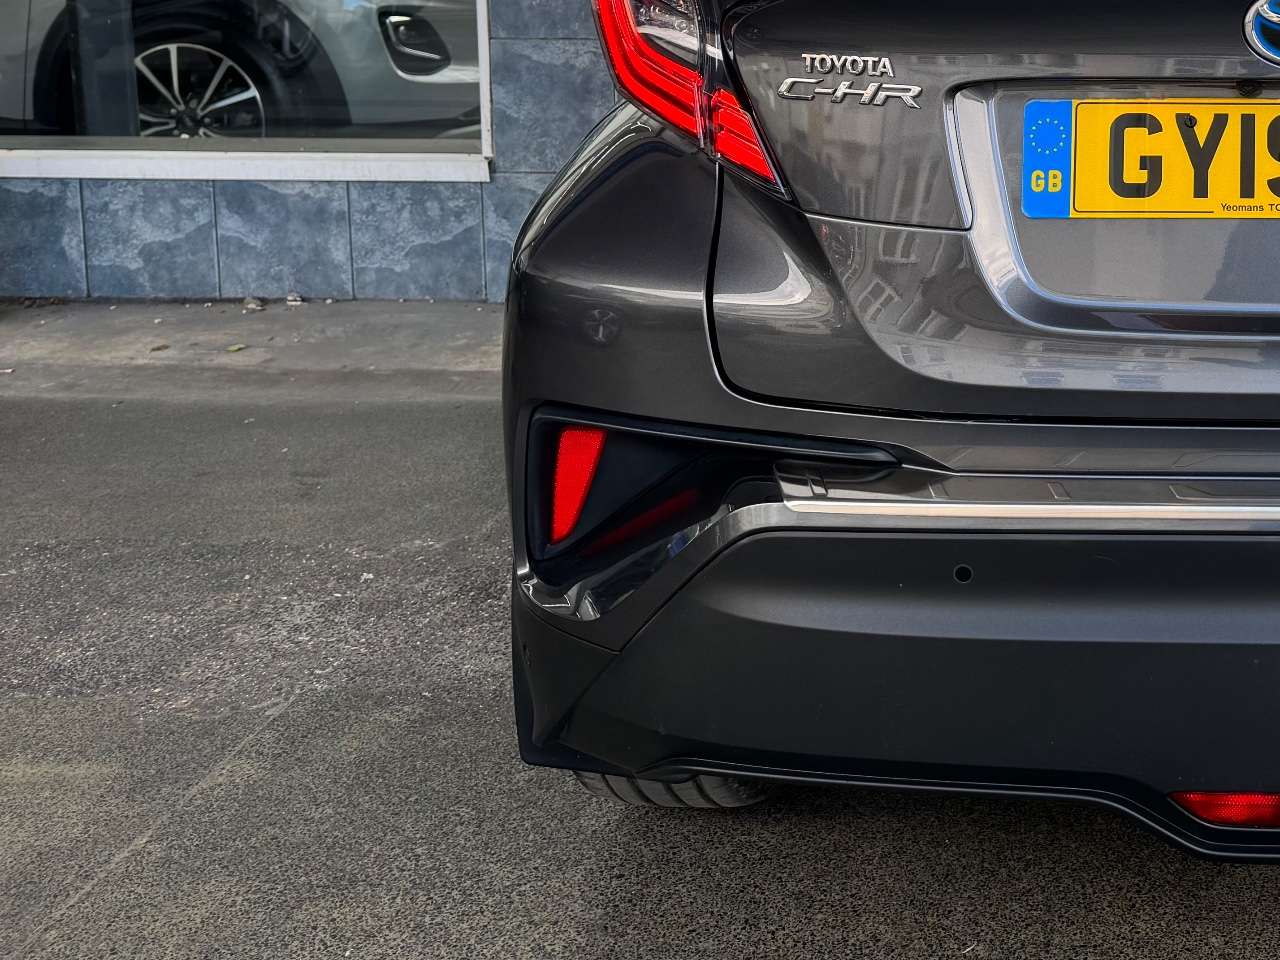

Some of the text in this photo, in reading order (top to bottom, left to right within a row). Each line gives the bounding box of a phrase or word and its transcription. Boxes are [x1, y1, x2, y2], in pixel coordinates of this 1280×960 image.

[802, 53, 895, 77] TOYOTA
[777, 77, 922, 109] C-HR
[1031, 169, 1063, 192] GB
[1220, 203, 1264, 212] Yeomans
